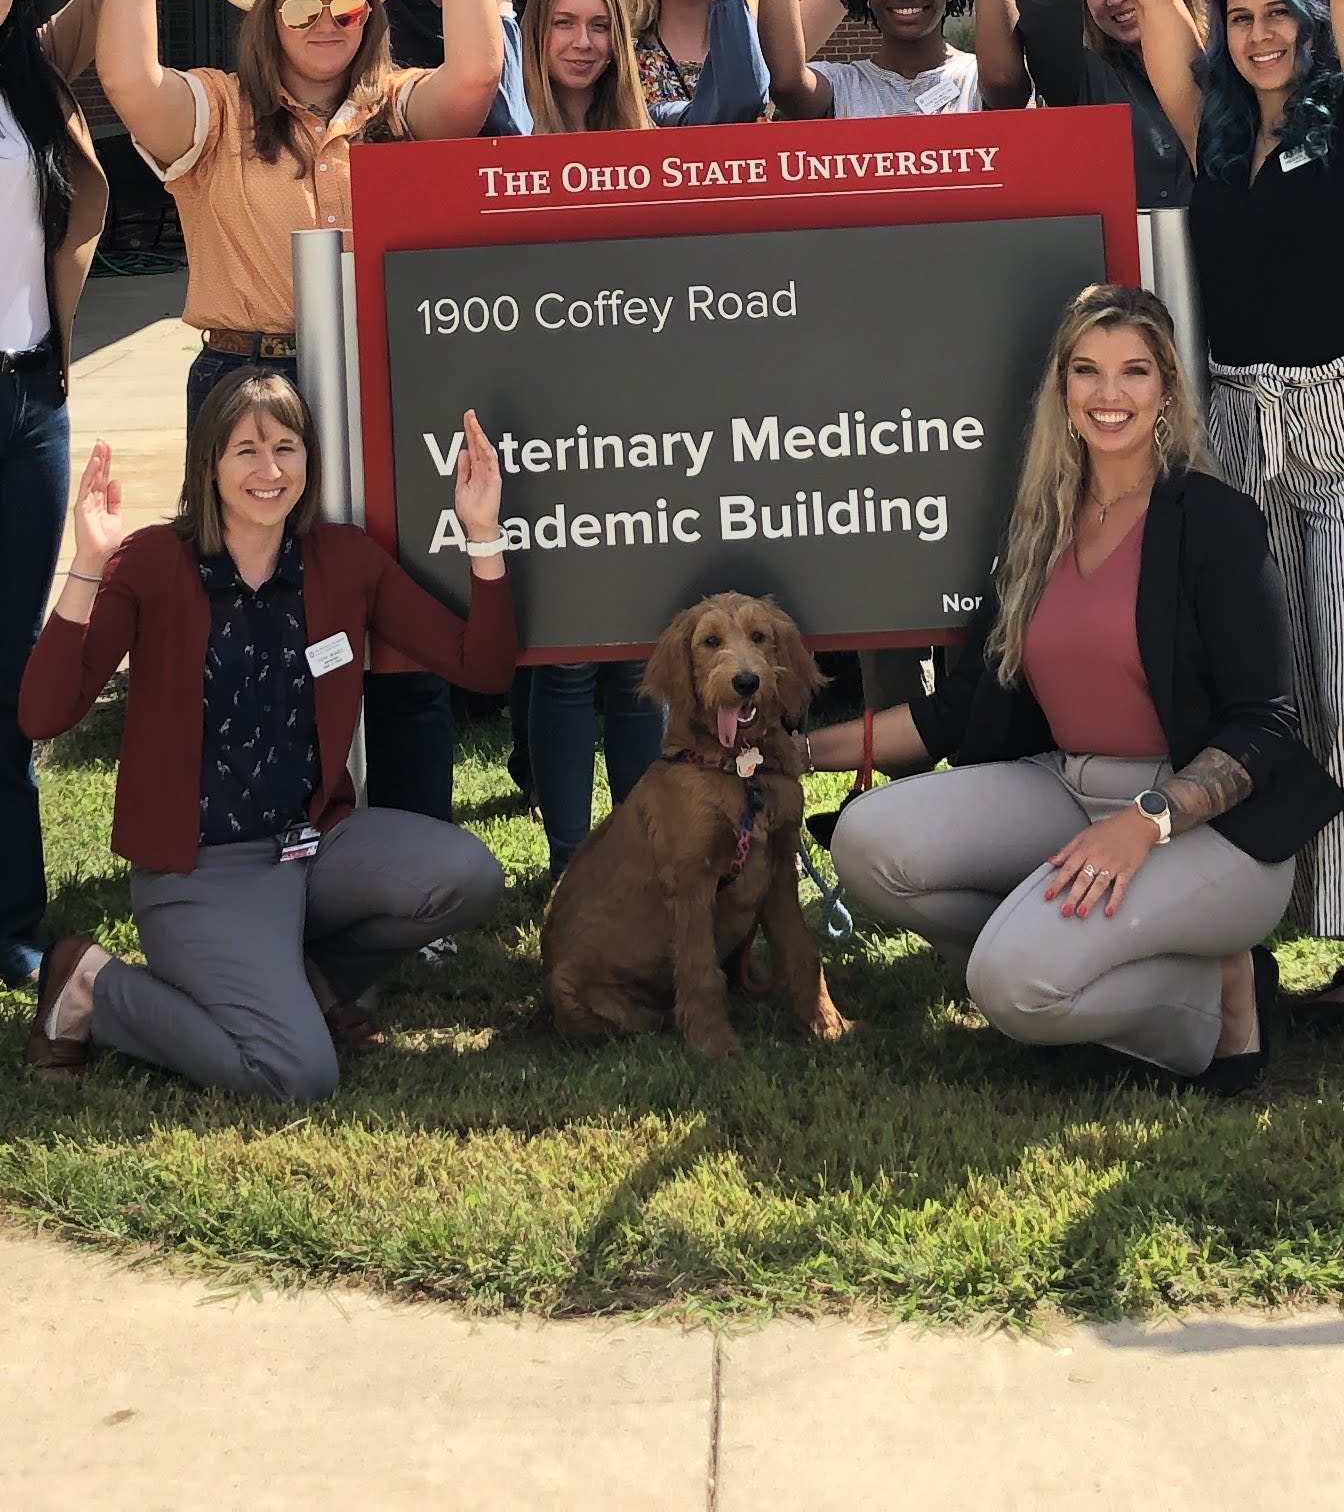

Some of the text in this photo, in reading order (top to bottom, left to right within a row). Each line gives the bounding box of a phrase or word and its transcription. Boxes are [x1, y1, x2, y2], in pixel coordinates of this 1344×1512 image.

[478, 147, 1000, 197] THE OHIO STATE UNIVERSITY
[416, 280, 797, 336] 1900 Coffey Road
[422, 407, 985, 477] Vterinary Medicine
[428, 487, 948, 555] Aademic Building
[942, 593, 983, 613] Nor
